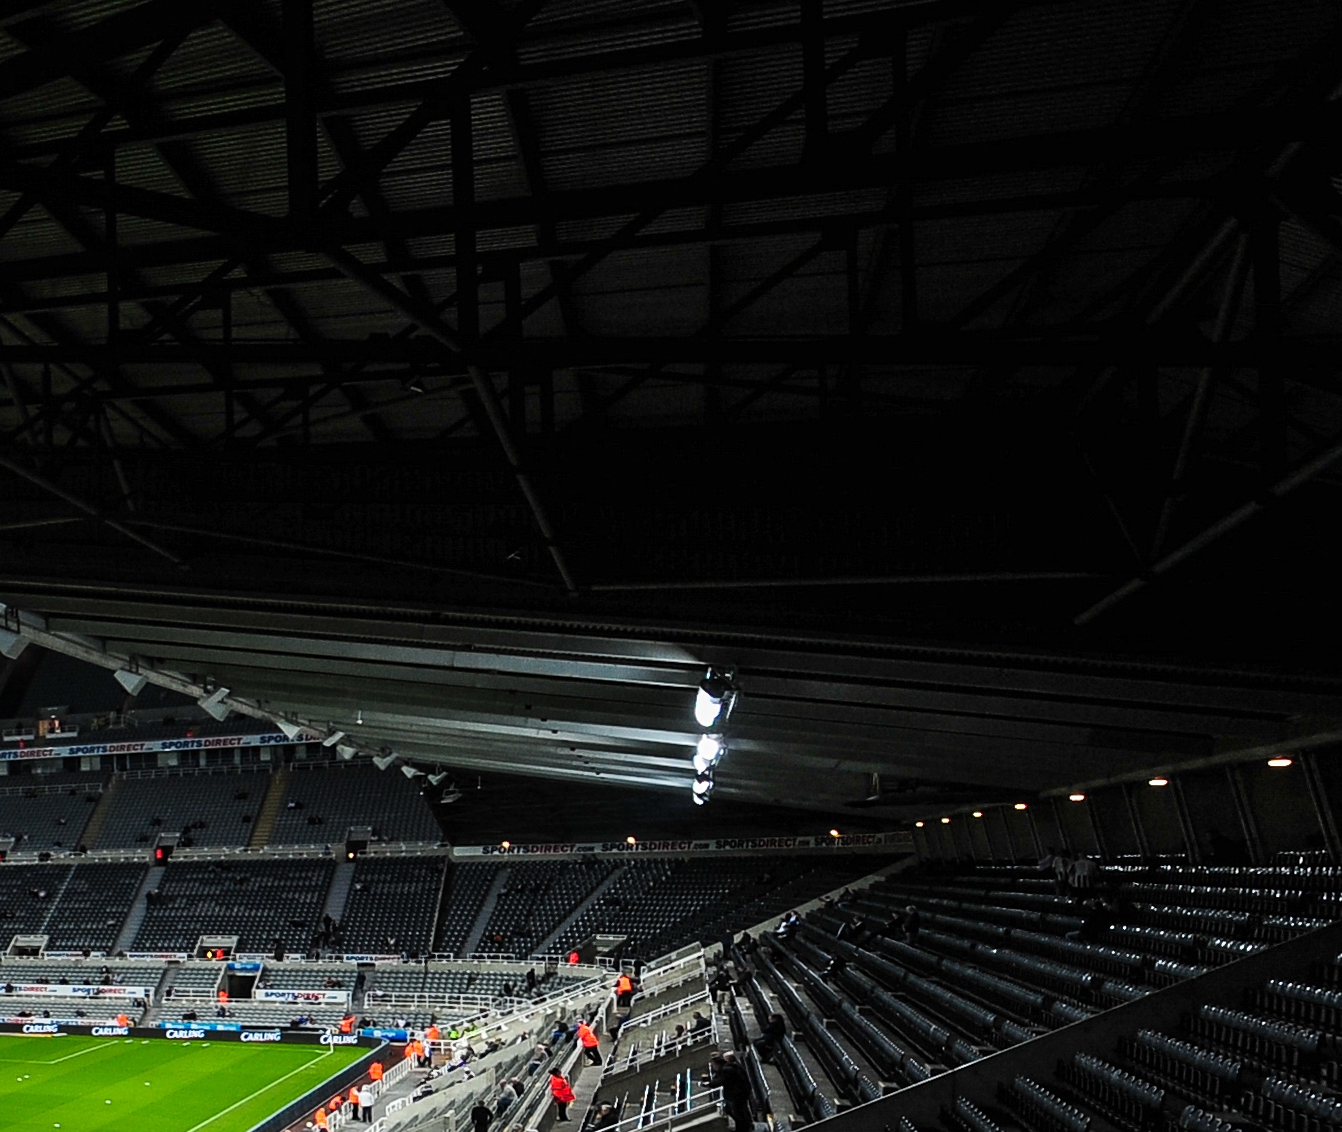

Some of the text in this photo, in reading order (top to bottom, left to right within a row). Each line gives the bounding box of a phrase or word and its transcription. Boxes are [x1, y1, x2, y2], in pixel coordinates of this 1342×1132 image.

[22, 1023, 59, 1034] CARLING
[91, 1026, 129, 1036] CARLING
[166, 1029, 206, 1040] CARLING
[240, 1031, 282, 1042] CARLING
[320, 1033, 359, 1045] CARLING
